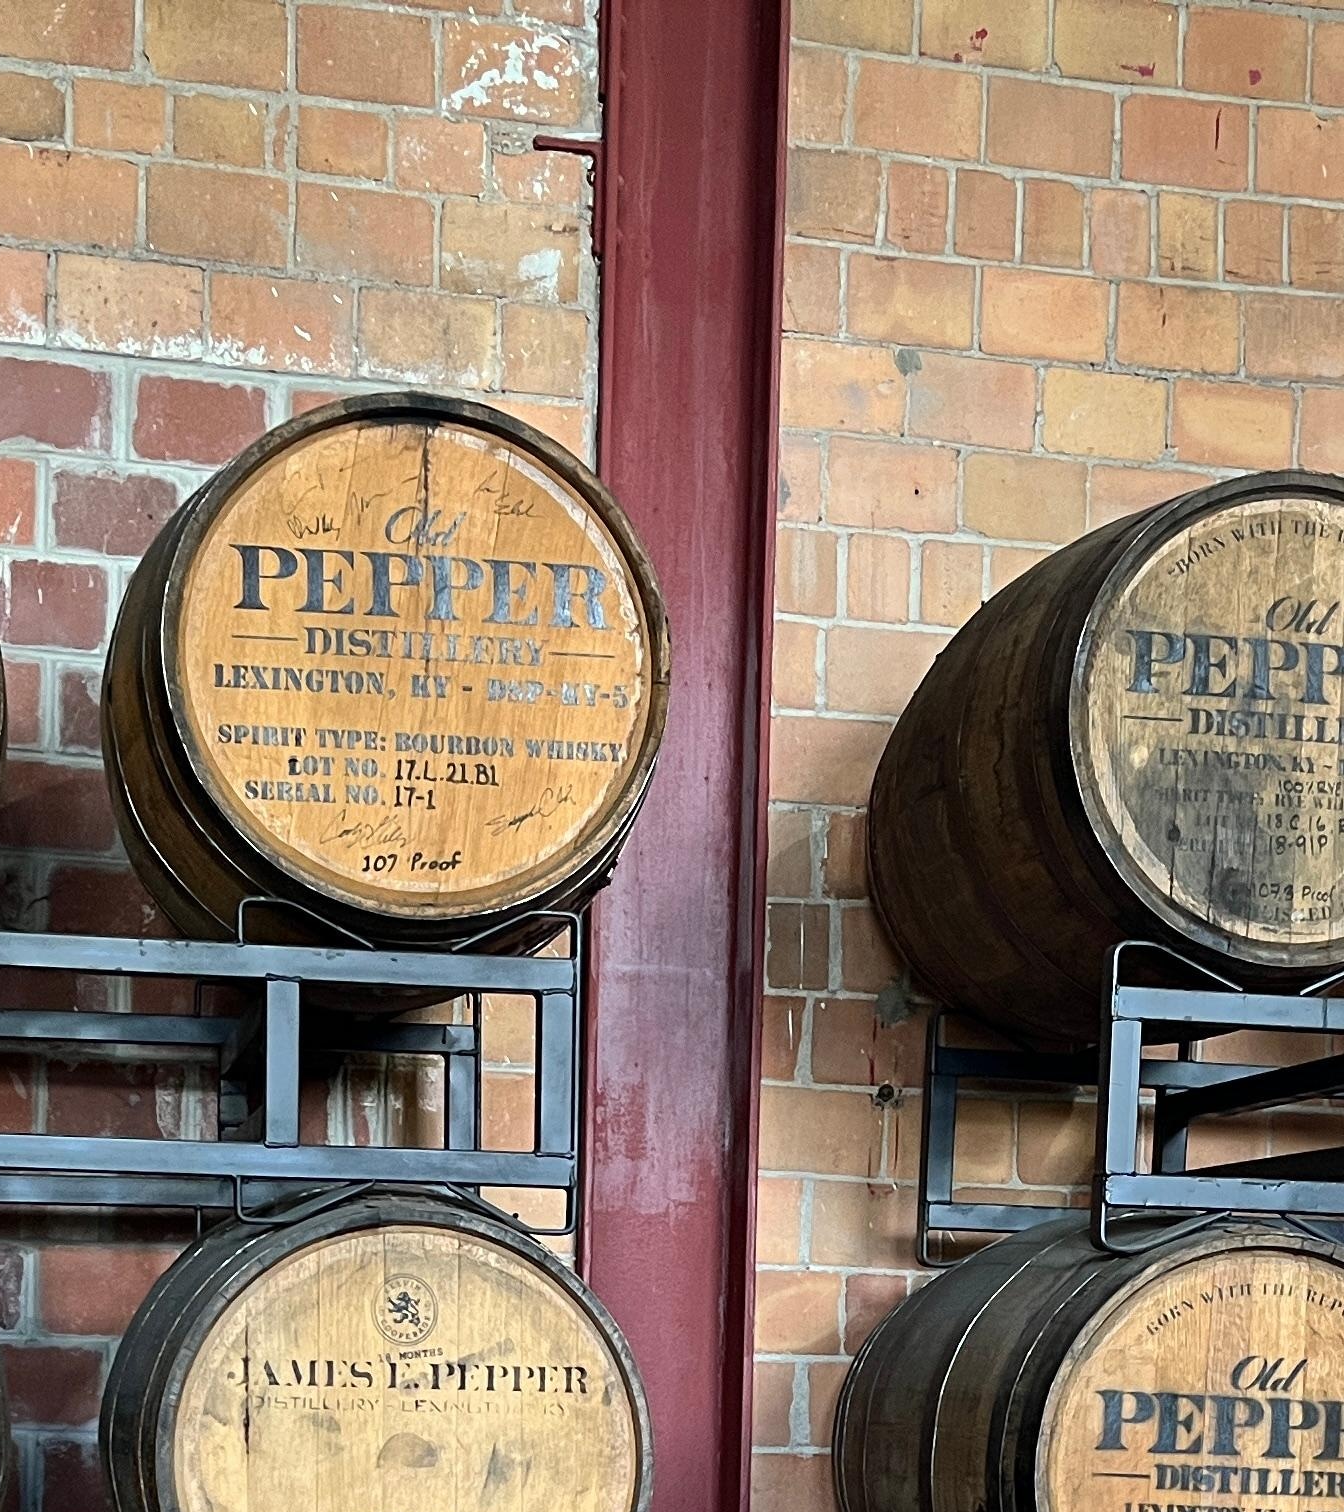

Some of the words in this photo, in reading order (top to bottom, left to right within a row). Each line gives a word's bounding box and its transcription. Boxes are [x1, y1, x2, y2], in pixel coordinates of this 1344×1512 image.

[385, 505, 468, 548] Old
[1232, 520, 1282, 543] WITH
[1292, 520, 1330, 538] THE
[229, 544, 613, 631] PEPPER
[1266, 596, 1340, 636] Old
[304, 627, 549, 667] DISTILLERY
[213, 664, 396, 700] LEXINGTON,
[411, 675, 451, 700] KY
[218, 725, 306, 747] SPIRIT
[315, 728, 387, 751] TYPE:
[394, 732, 515, 758] BOURBON
[525, 739, 624, 763] WHISKY
[287, 756, 334, 778] LOT
[345, 758, 386, 778] NO.
[1291, 756, 1316, 774] KY
[245, 781, 336, 804] SERIAL
[345, 784, 386, 806] NO.
[394, 785, 436, 810] 17-1
[362, 854, 397, 873] 107
[410, 851, 462, 871] Proof
[1199, 1283, 1254, 1305] WITH
[227, 1357, 374, 1390] JAMES
[430, 1362, 589, 1394] PEPPER
[1230, 1354, 1308, 1394] Old
